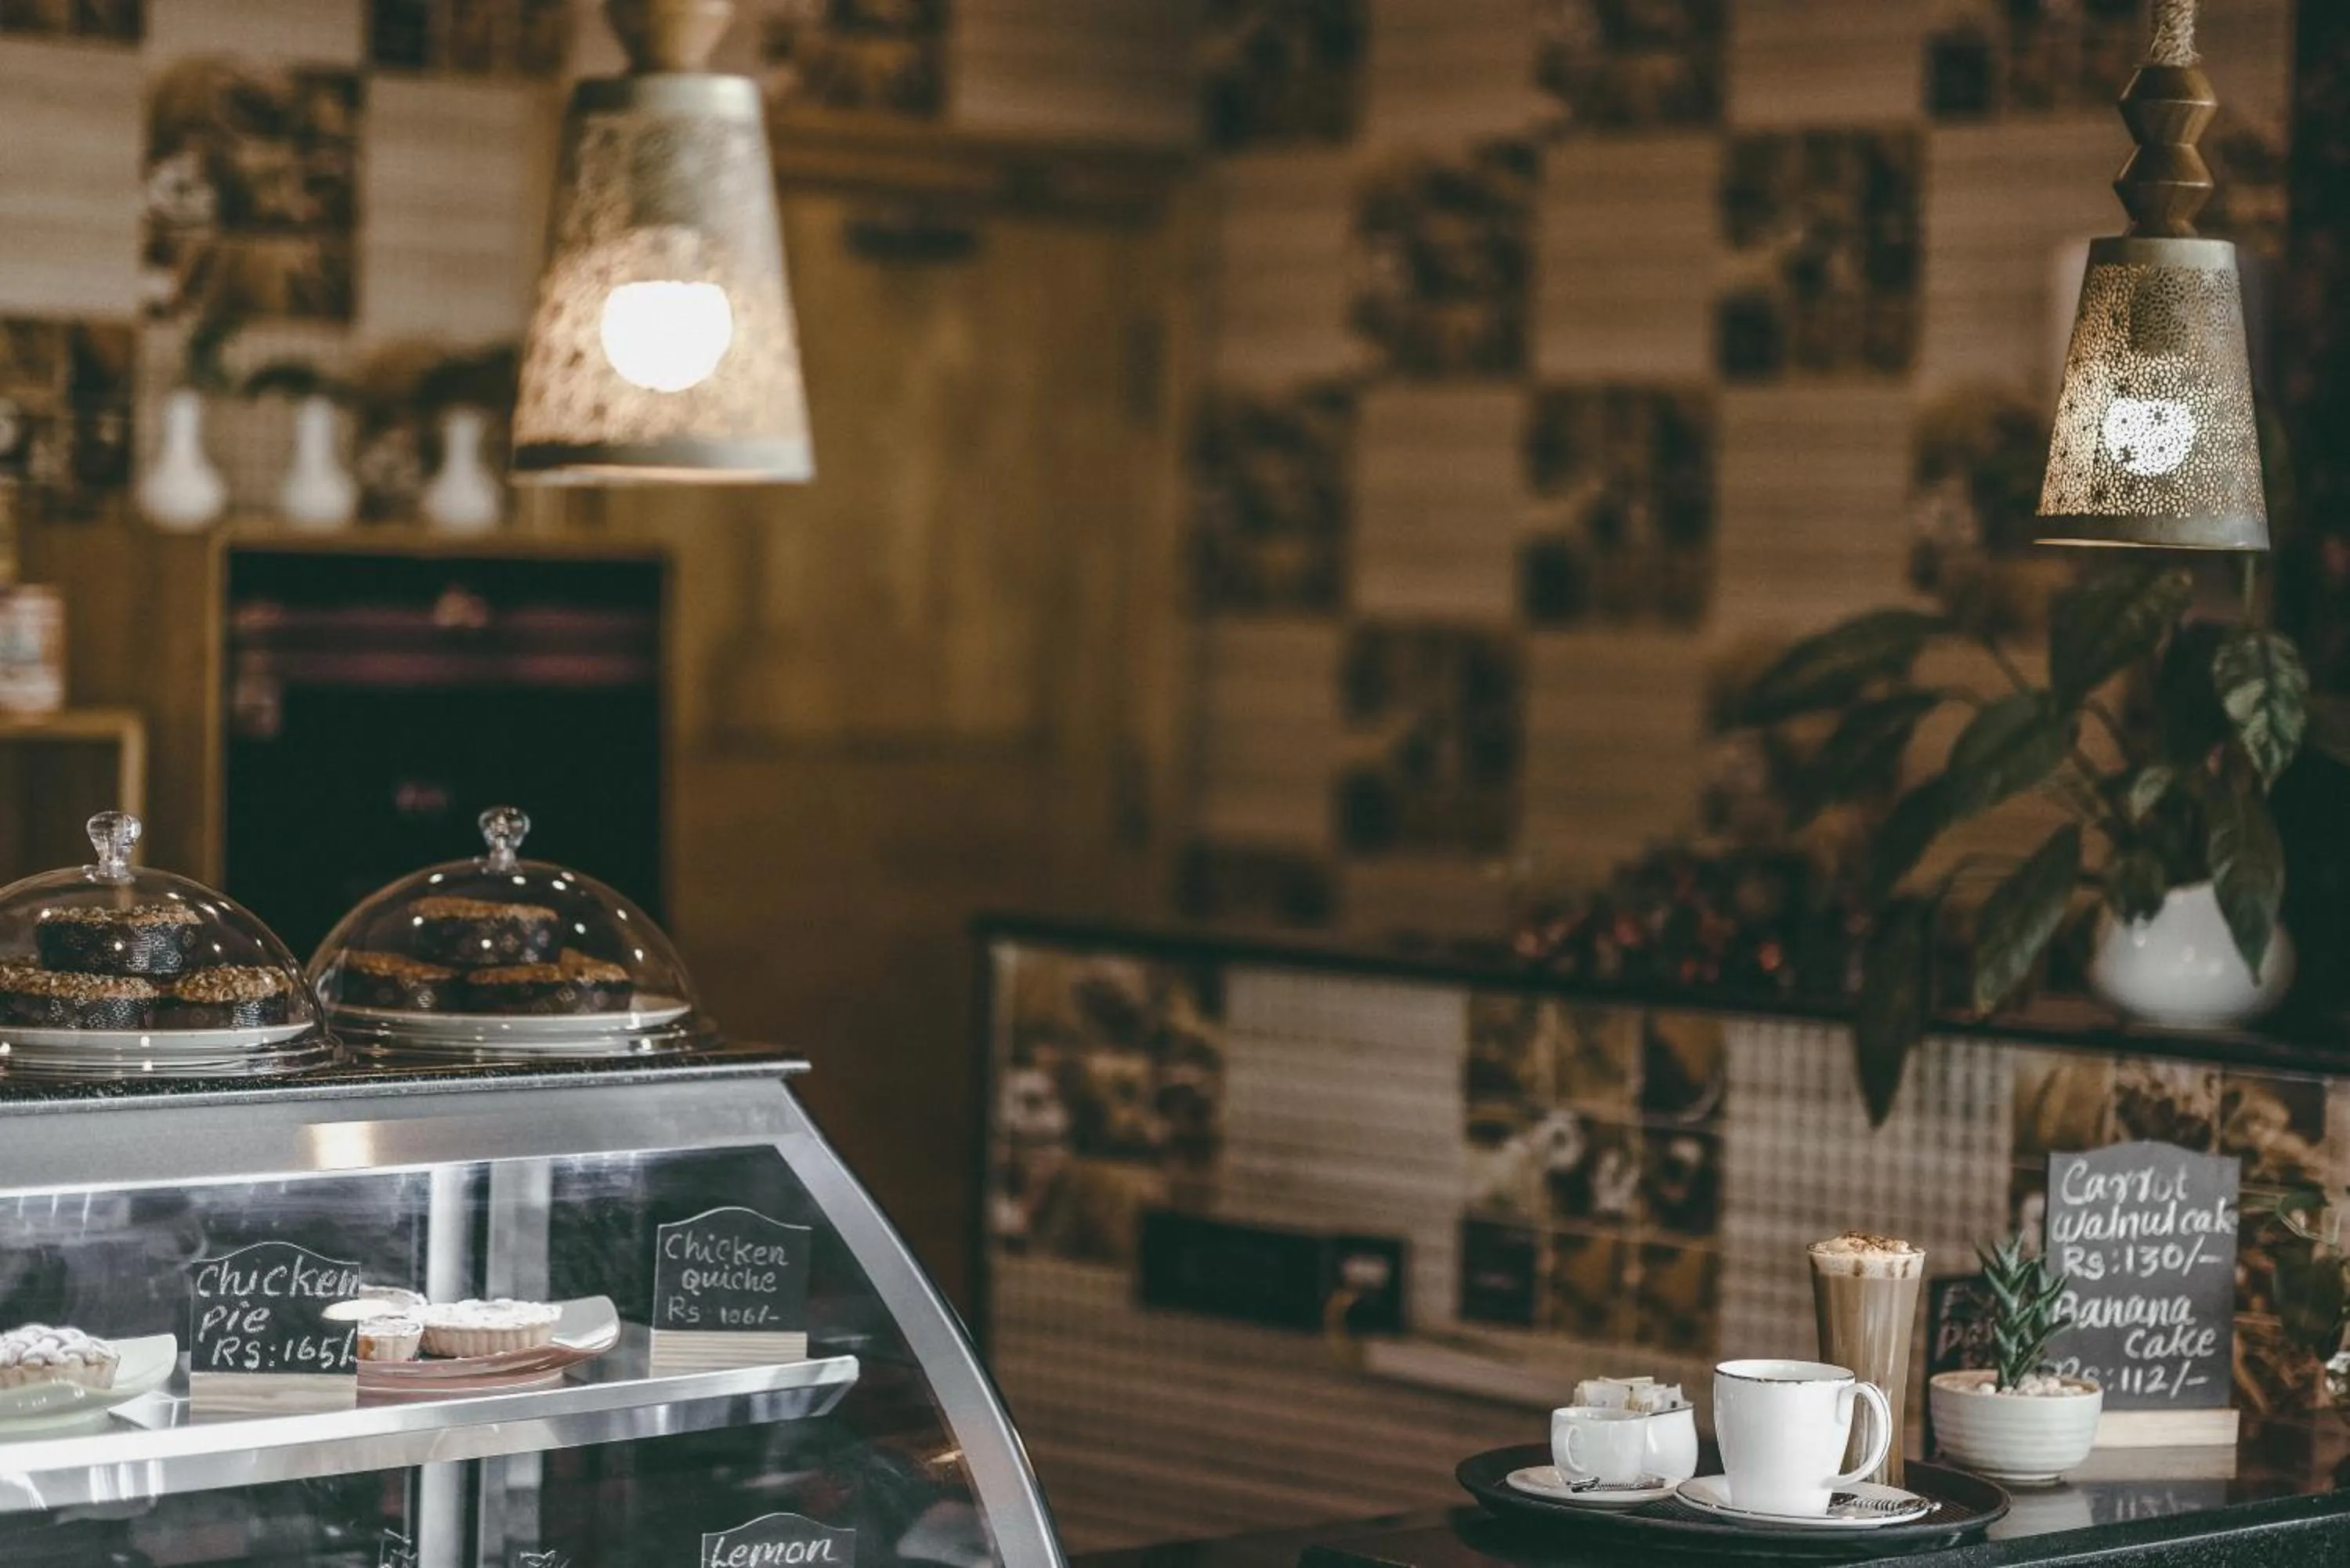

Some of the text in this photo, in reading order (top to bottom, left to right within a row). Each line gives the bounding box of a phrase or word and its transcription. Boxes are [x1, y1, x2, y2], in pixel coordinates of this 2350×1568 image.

[2062, 1158, 2188, 1205] Carrot
[665, 1230, 789, 1266] Chicken
[682, 1264, 777, 1295] Quiche
[2052, 1290, 2196, 1329] Banana
[710, 1536, 839, 1568] Lemon
